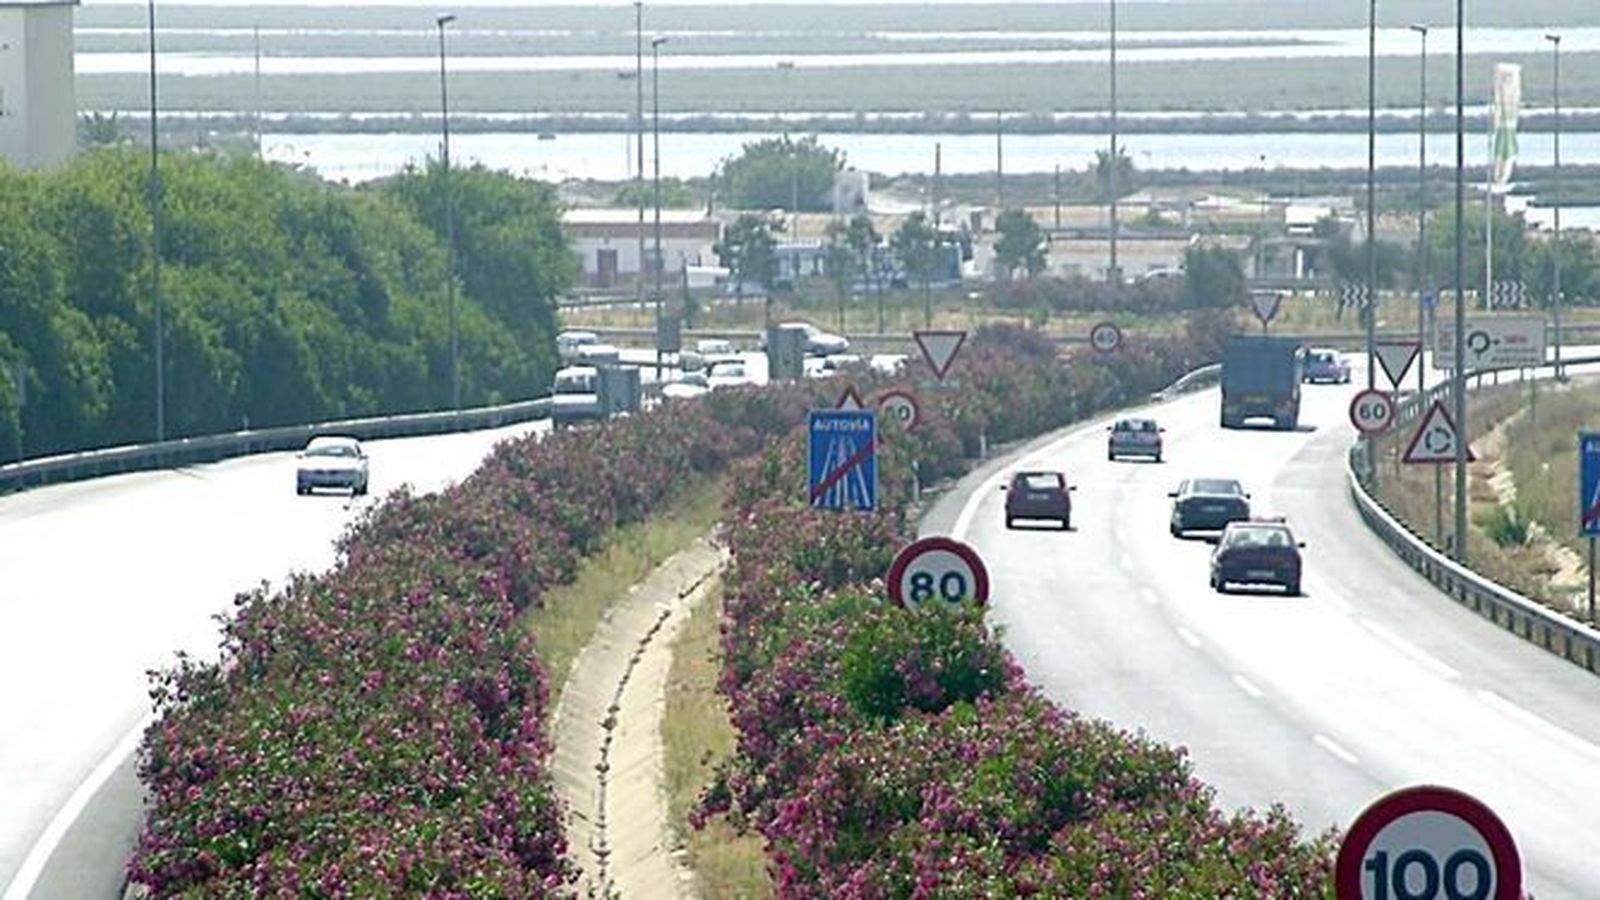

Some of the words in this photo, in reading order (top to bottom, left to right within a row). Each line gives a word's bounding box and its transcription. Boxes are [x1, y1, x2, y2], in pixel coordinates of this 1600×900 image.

[1359, 403, 1386, 420] 60
[910, 571, 967, 603] 80
[1365, 849, 1492, 900] 100
